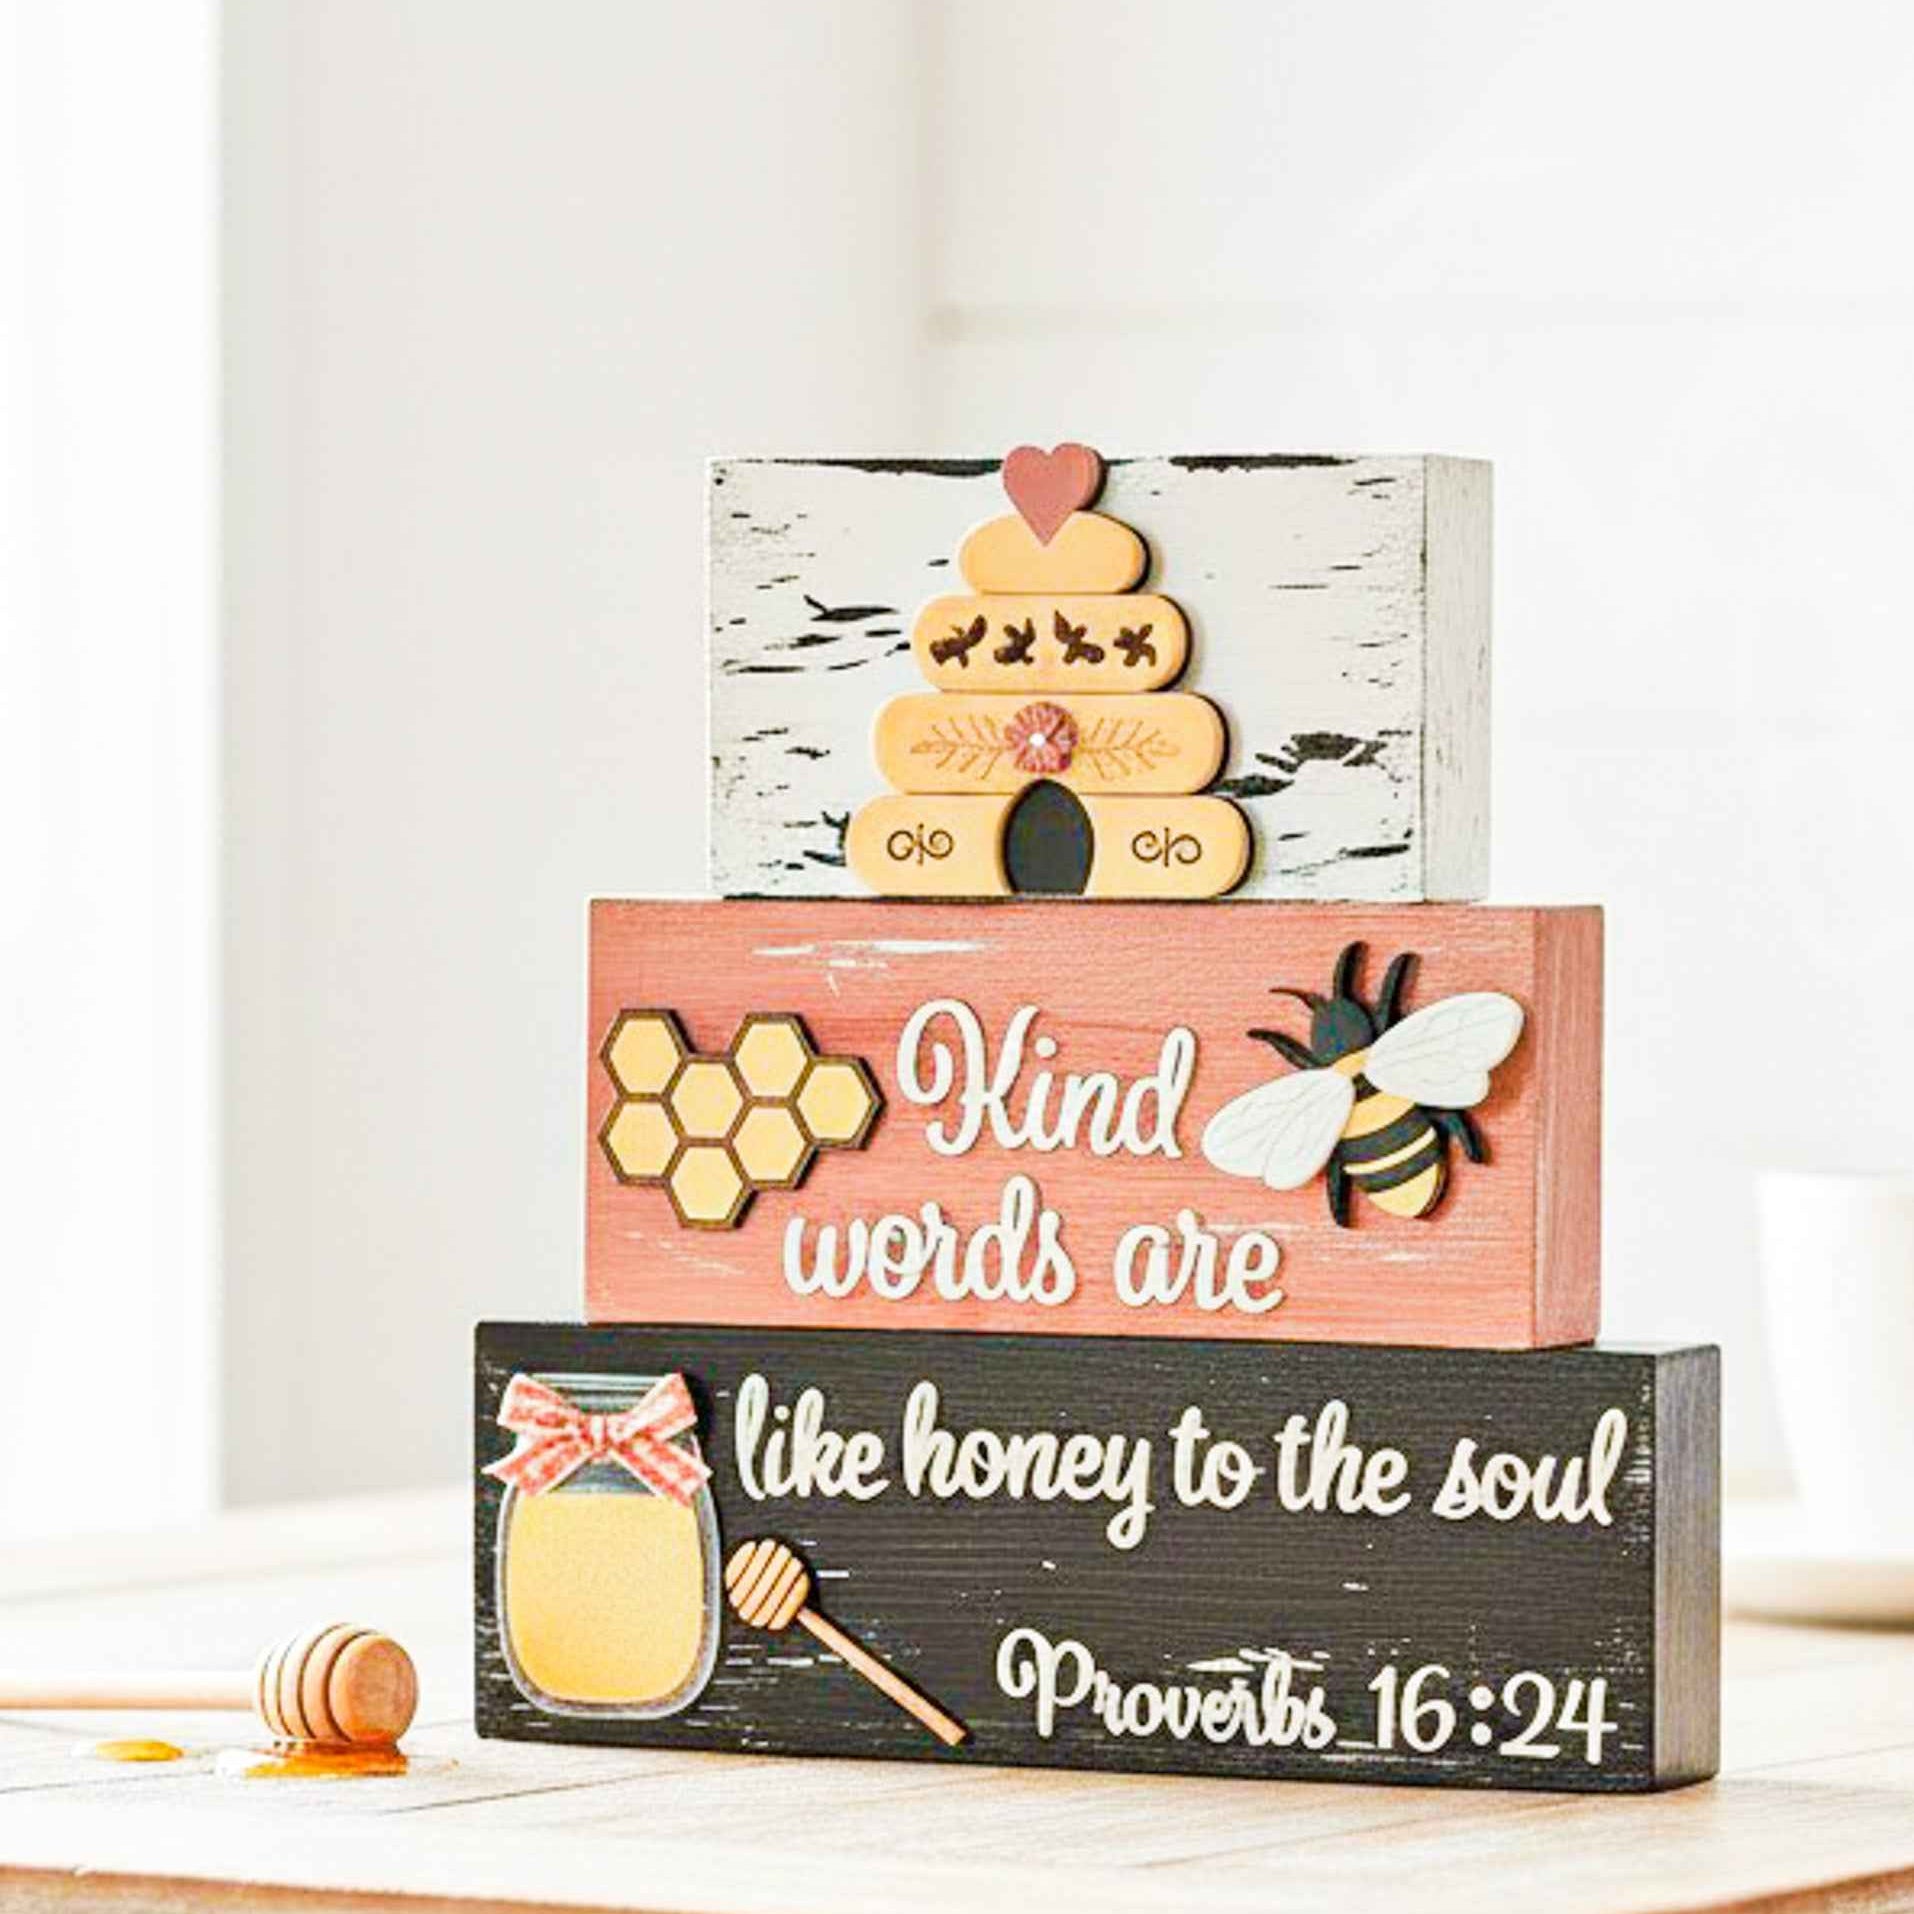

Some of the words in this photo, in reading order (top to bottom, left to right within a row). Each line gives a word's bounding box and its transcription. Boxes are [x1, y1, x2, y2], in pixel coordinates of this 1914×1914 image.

[899, 999, 1196, 1157] Kind
[783, 1174, 1076, 1305] words
[1115, 1209, 1286, 1313] are
[735, 1373, 889, 1501] like
[902, 1380, 1155, 1549] honey
[1169, 1405, 1264, 1509] to
[1276, 1401, 1410, 1516] the
[1433, 1408, 1627, 1527] soul
[998, 1628, 1337, 1750] Proverbs
[1368, 1663, 1618, 1765] 16:24
